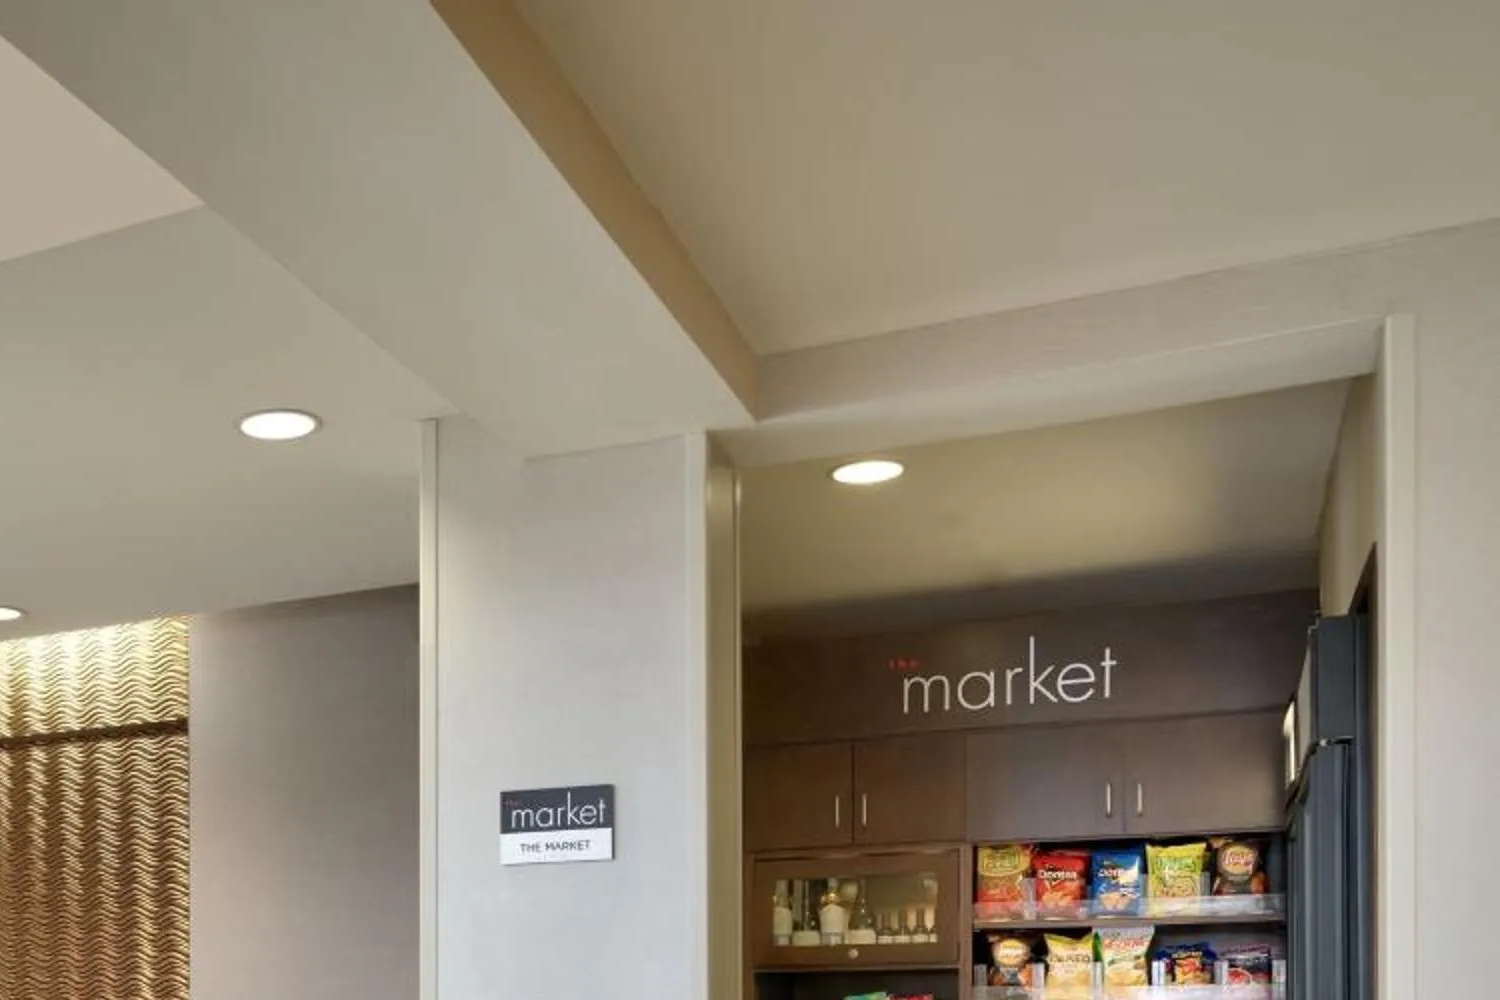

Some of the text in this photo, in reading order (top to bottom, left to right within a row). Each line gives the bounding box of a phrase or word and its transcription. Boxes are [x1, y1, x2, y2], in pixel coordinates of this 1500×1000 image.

[903, 635, 1117, 715] market
[511, 791, 606, 829] market
[518, 839, 591, 853] THE MARKET
